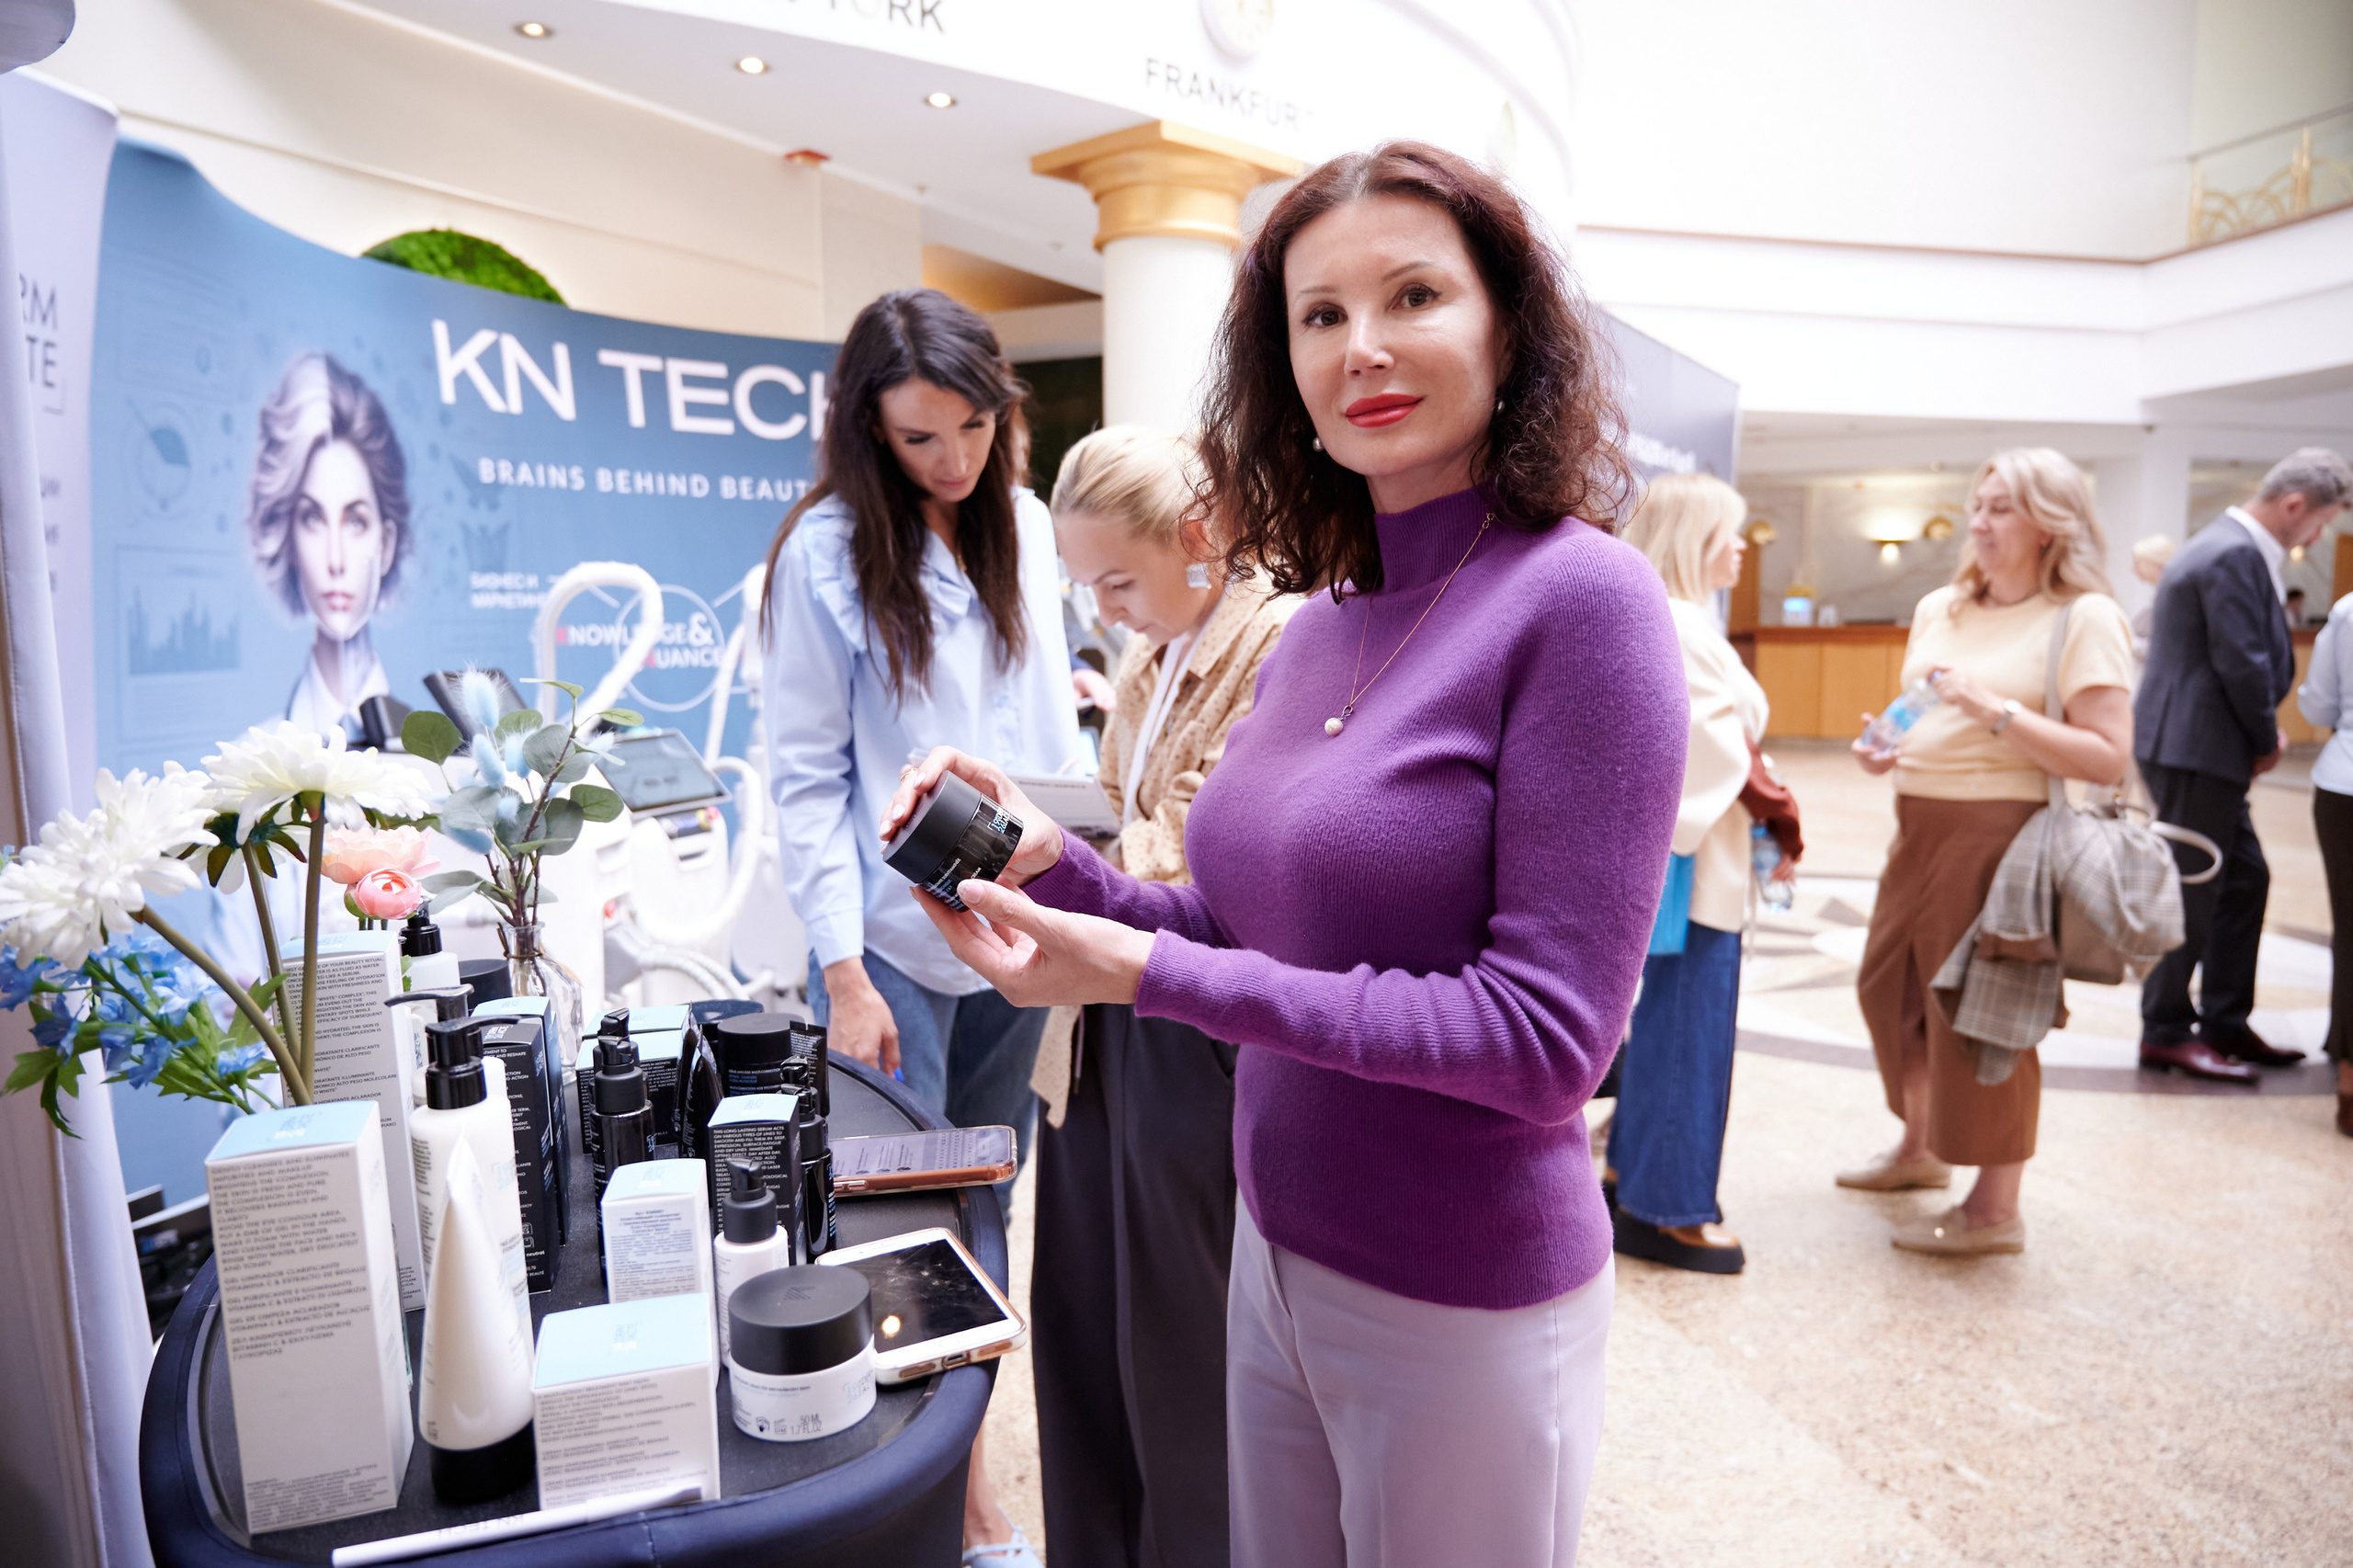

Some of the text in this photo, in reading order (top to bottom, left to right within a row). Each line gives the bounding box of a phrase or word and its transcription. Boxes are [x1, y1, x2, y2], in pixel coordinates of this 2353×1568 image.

[431, 318, 576, 422] KN
[478, 457, 810, 502] BRAINS BEHIND BEAUT
